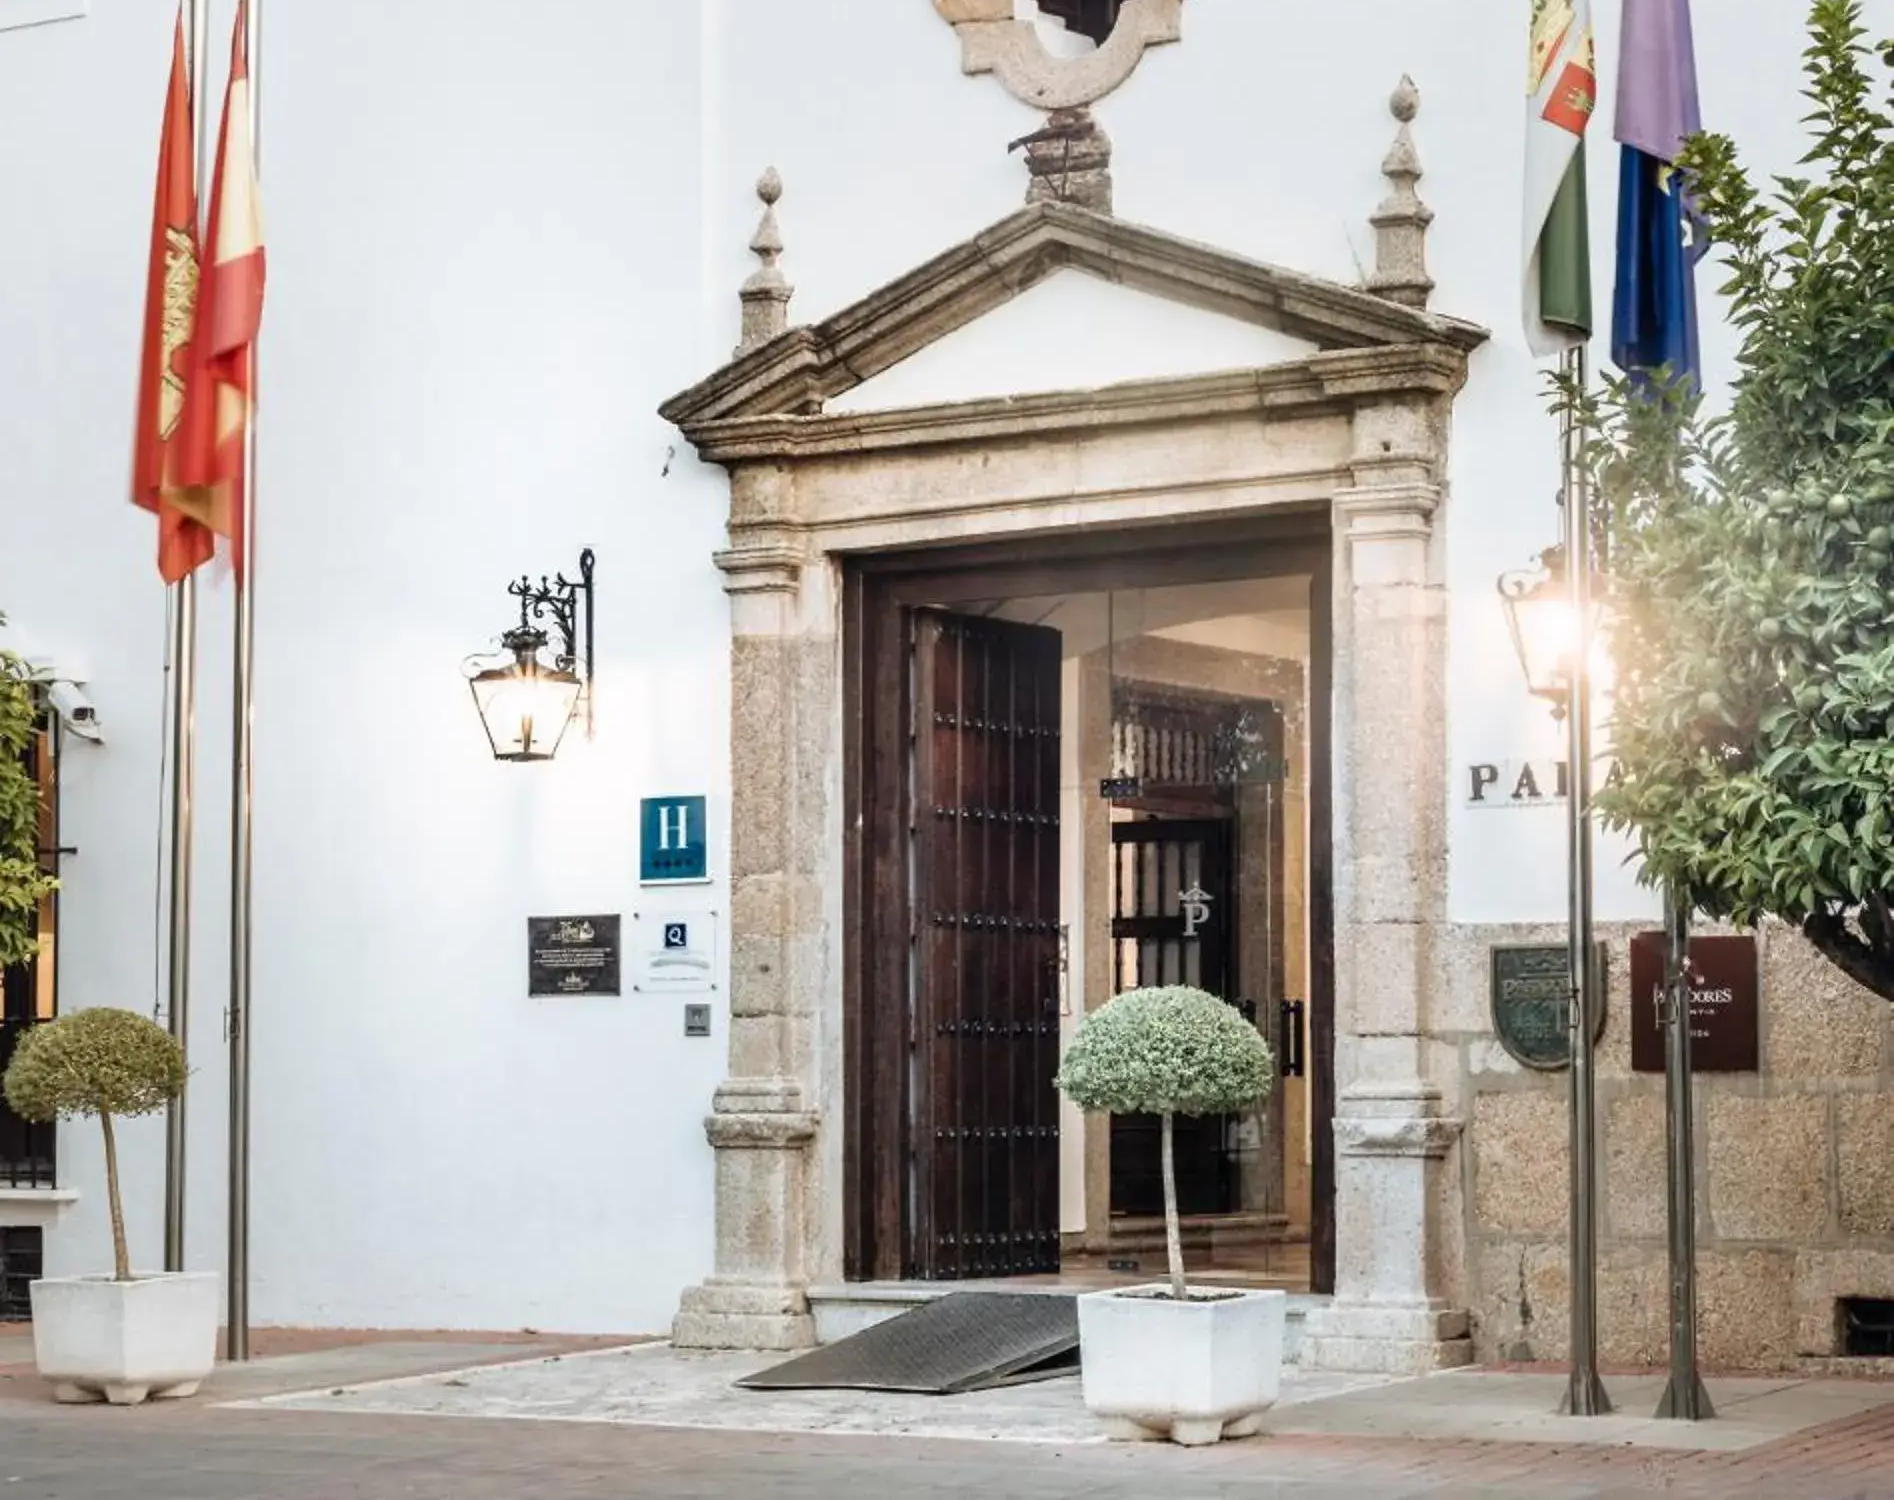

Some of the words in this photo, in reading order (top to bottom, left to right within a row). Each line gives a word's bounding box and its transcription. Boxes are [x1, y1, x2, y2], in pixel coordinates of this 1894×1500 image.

[658, 805, 688, 850] H
[668, 927, 684, 945] Q
[1183, 903, 1209, 936] P
